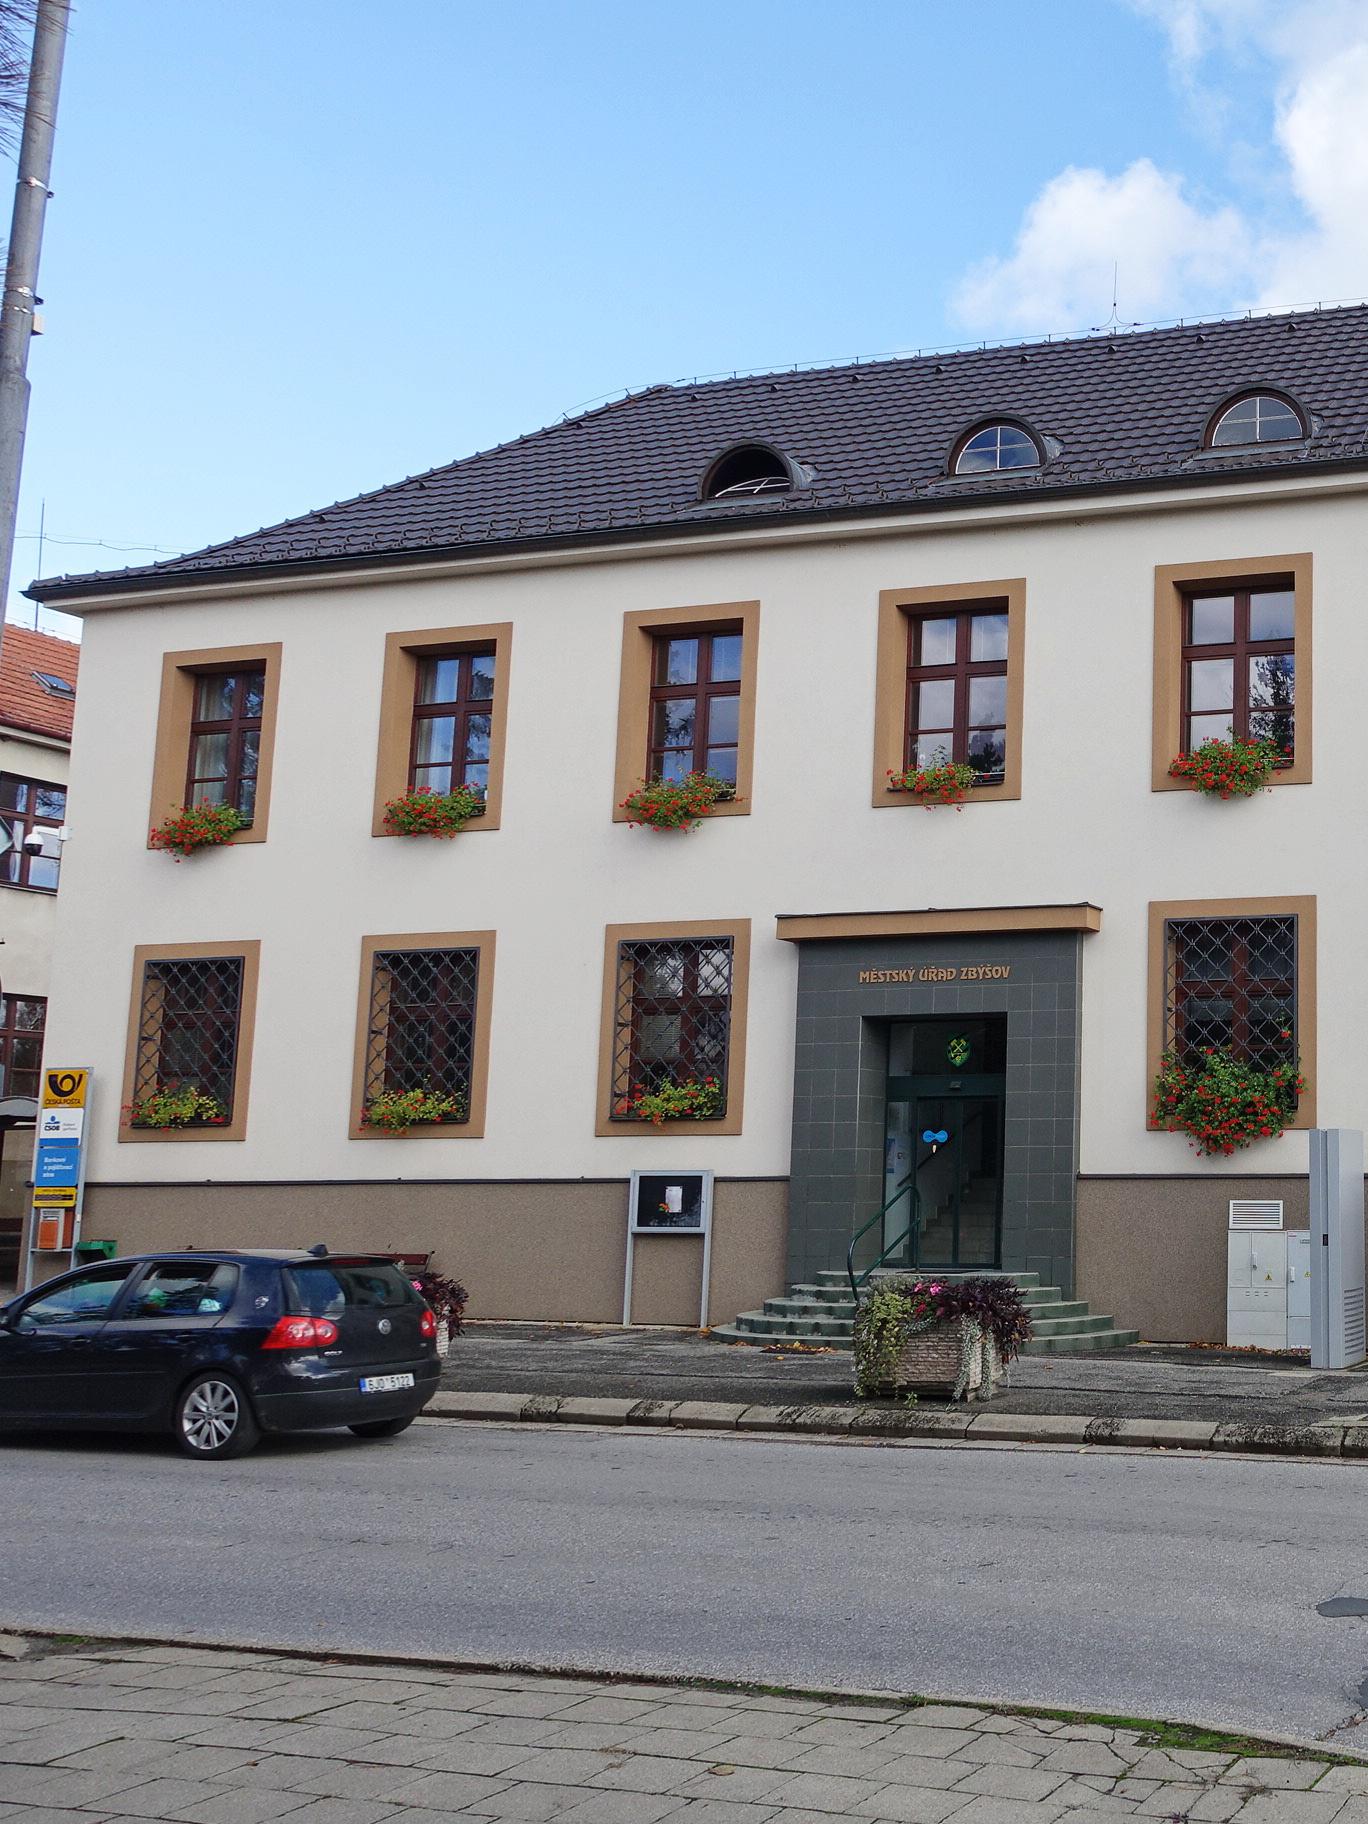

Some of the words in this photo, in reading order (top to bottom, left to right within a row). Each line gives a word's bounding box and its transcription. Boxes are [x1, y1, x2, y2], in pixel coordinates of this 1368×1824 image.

[859, 967, 916, 983] MĚSTSKÝ
[919, 966, 957, 982] ÚŘAD
[960, 964, 1011, 980] ZBÝŠOV
